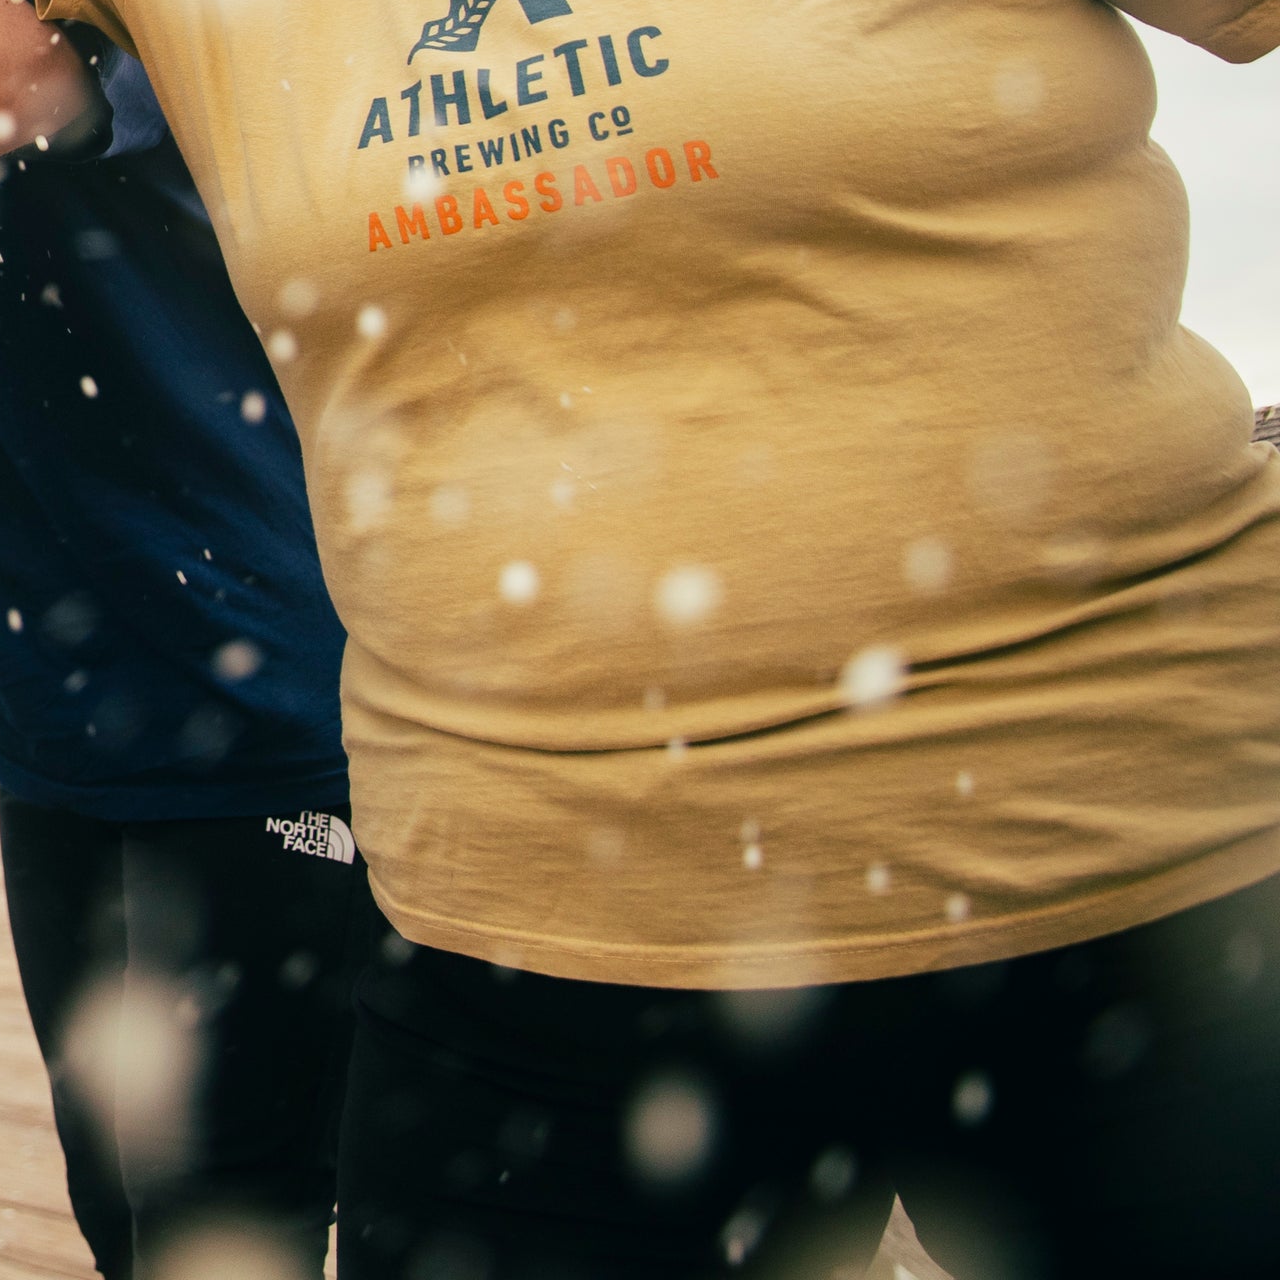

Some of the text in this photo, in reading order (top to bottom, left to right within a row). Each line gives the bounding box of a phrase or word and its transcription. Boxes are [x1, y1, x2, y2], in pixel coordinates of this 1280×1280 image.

[357, 25, 670, 149] ATHLETIC
[367, 139, 719, 252] AMBASSADOR
[265, 817, 329, 842] NORTH
[283, 834, 327, 858] FACE
